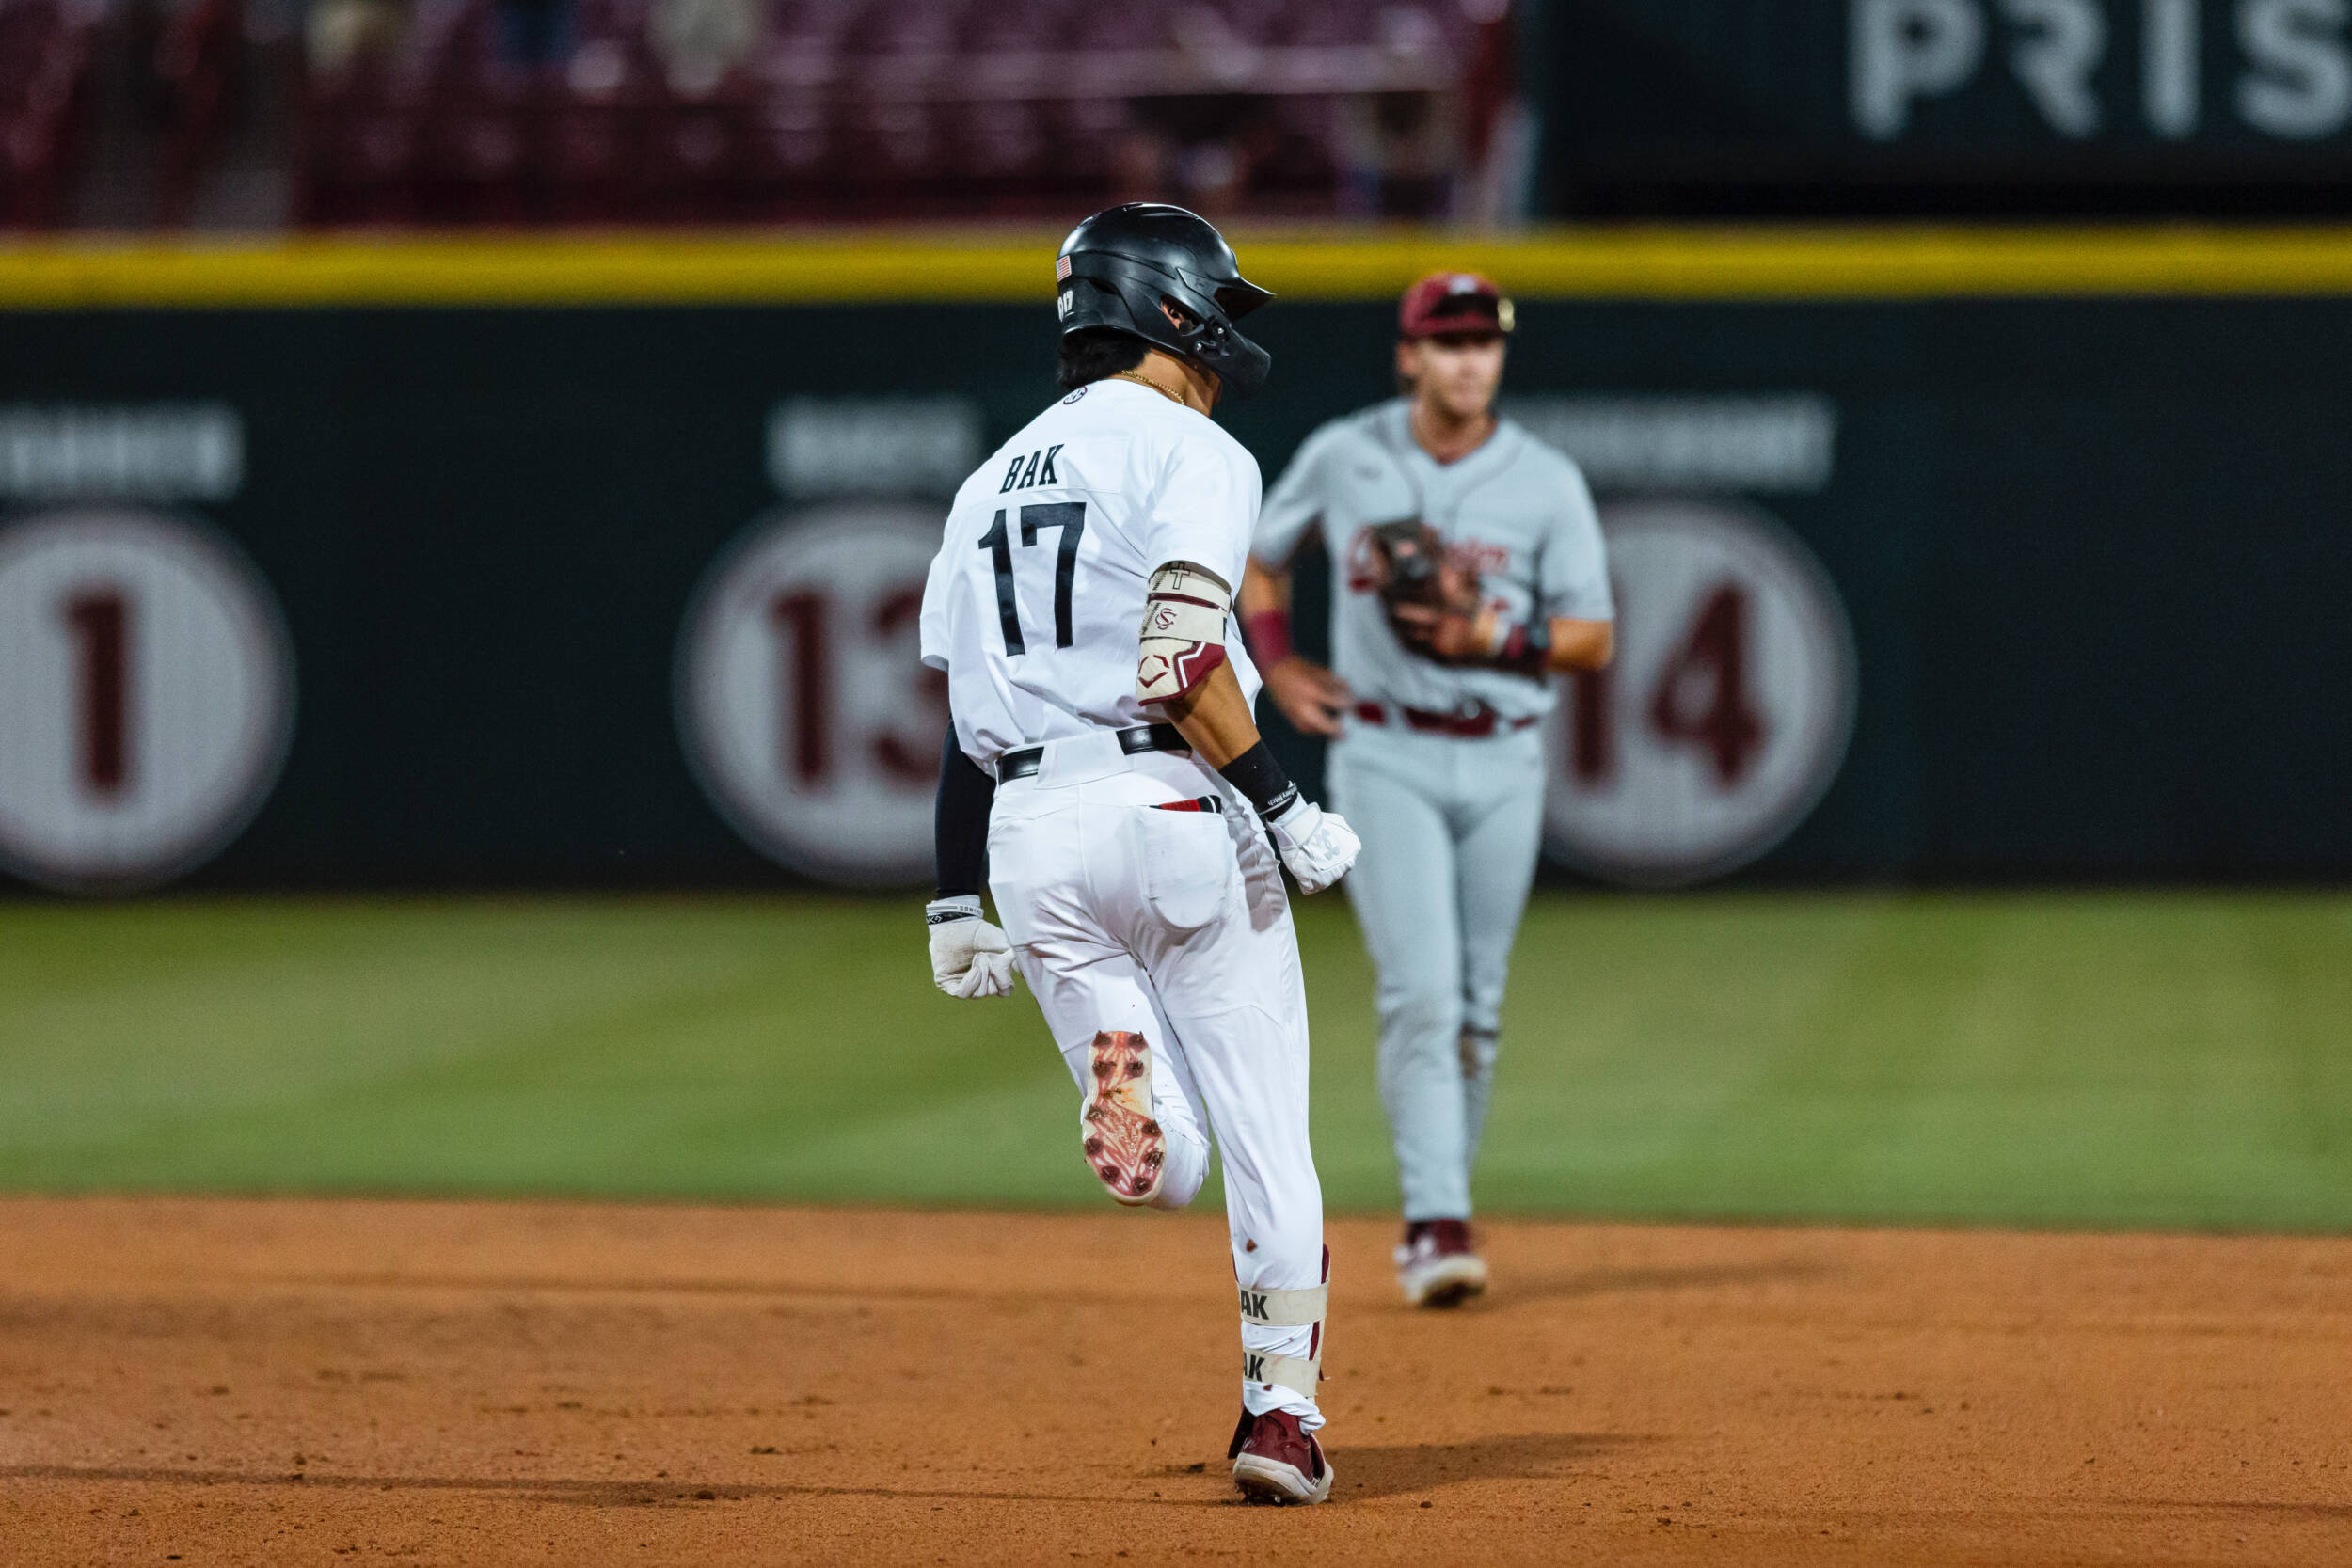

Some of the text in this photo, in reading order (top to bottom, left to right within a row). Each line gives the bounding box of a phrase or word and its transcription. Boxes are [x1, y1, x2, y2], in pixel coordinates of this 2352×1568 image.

[1850, 0, 2352, 137] PRIS
[999, 443, 1065, 494] BAK
[978, 501, 1087, 657] 17
[58, 587, 134, 800] 1
